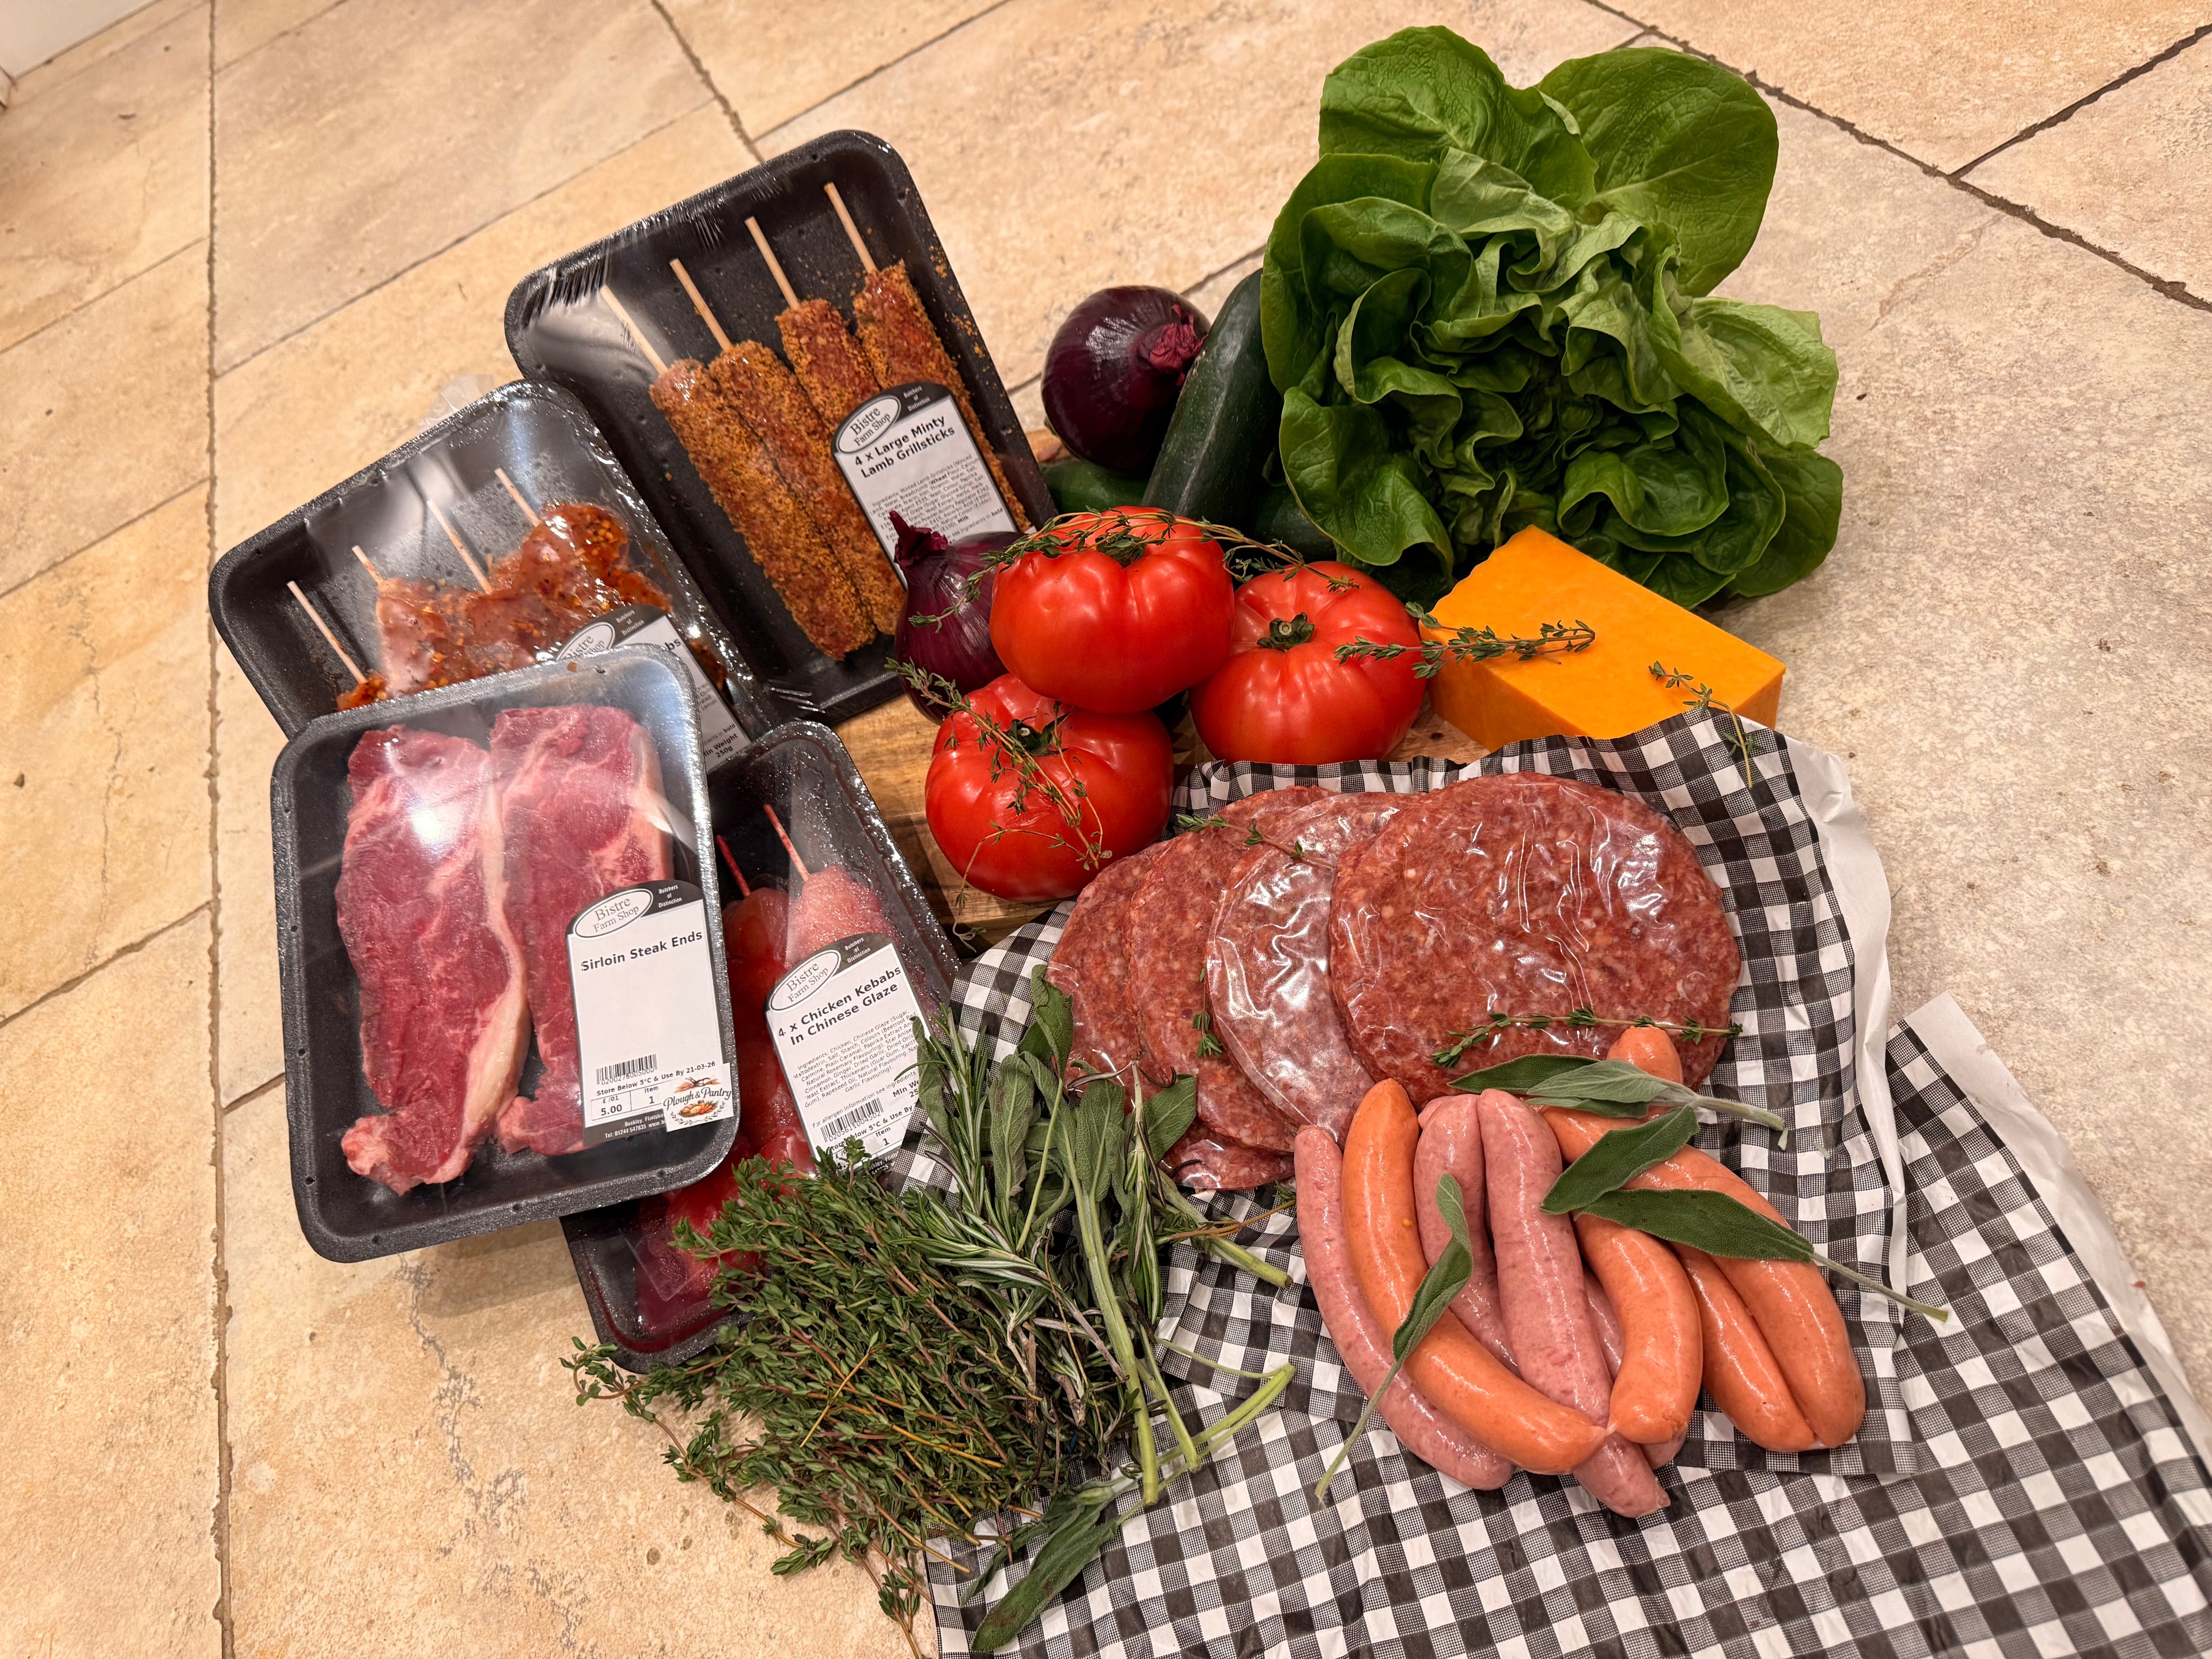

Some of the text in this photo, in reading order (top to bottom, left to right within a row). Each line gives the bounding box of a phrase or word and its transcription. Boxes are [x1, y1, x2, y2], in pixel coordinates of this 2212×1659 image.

[903, 386, 922, 398] Butchers
[907, 397, 930, 411] Distinction
[850, 407, 881, 436] Bistre
[854, 414, 893, 446] Farm Shop
[855, 416, 944, 465] 4 x Large Minty
[861, 427, 955, 478] Lamb Grillsticks
[991, 507, 1003, 517] bold
[616, 610, 635, 623] Butchers
[622, 620, 645, 635] Distinction
[589, 641, 605, 654] hop
[723, 724, 736, 733] bold
[713, 734, 738, 750] Weight
[716, 746, 733, 757] 250g
[658, 885, 678, 894] Butchers
[594, 899, 631, 921] Bistre
[658, 897, 682, 908] Distinction
[593, 906, 639, 933] Farm Shop
[581, 931, 702, 971] Sirloin Steak Ends
[844, 937, 864, 950] Butchers
[847, 948, 871, 963] Distinction
[786, 961, 820, 991] Bistre
[787, 968, 828, 1002] Farm Shop
[779, 967, 901, 1036] 4 x Chicken Kebabs
[790, 984, 897, 1046] In Chinese Glaze
[798, 1010, 909, 1070] Ingredients: Chicken, Chinese Glaze (Sugar,
[840, 1043, 860, 1054] Starch,
[861, 1032, 881, 1044] Colours
[881, 1018, 906, 1033] (Beetroot
[801, 1068, 825, 1082] Carmine,
[825, 1060, 839, 1069] Plain
[839, 1047, 863, 1062] Caramel,
[863, 1037, 883, 1049] Paprika
[884, 1027, 903, 1039] Extract
[806, 1072, 825, 1086] Natural
[826, 1059, 852, 1075] Rosemary
[885, 1036, 896, 1044] Star
[618, 1082, 638, 1091] Below
[686, 1060, 715, 1073] 21-03-26
[805, 1077, 833, 1093] Cinnamon,
[834, 1066, 854, 1078] Ginger,
[854, 1057, 869, 1068] Dried
[869, 1049, 887, 1060] Garlic,
[887, 1040, 902, 1051] Dried
[819, 1080, 840, 1093] Extract,
[840, 1065, 869, 1081] Thickeners
[870, 1056, 885, 1067] (Guar
[885, 1049, 900, 1058] Gum,
[821, 1081, 847, 1098] Rapeseed
[858, 1066, 878, 1079] Natural
[845, 1082, 861, 1092] Garlic
[893, 1087, 907, 1097] Min
[601, 1096, 654, 1116] 5.00 1
[663, 1090, 694, 1111] Plough
[701, 1087, 732, 1100] Pantry
[822, 1109, 843, 1123] allergen
[844, 1093, 875, 1111] information
[886, 1071, 916, 1089] ingredients
[630, 1124, 646, 1132] 547835
[645, 1113, 664, 1122] Flintshir
[831, 1139, 844, 1150] tore
[889, 1111, 902, 1120] Use
[876, 1127, 891, 1137] Item
[882, 1138, 890, 1146] 1
